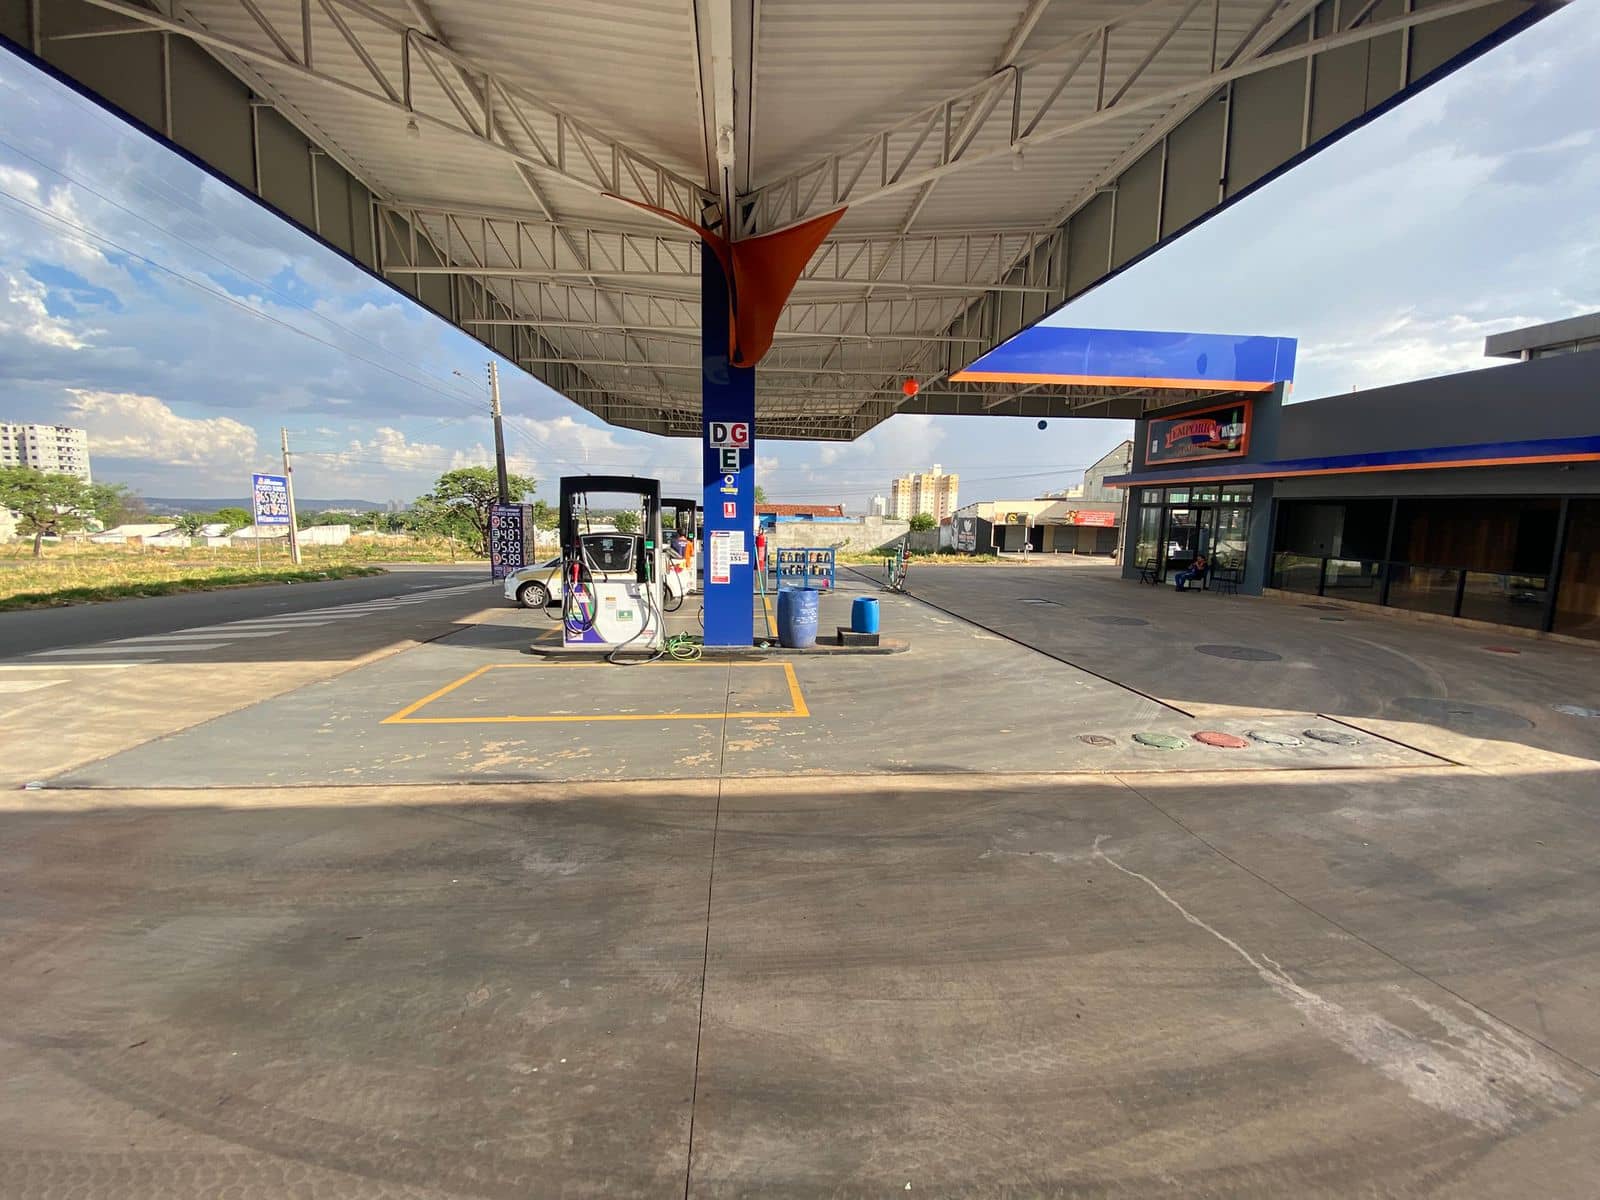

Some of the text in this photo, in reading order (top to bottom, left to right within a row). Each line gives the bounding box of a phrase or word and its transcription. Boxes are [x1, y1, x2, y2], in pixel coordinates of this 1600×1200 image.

[713, 424, 747, 443] D G
[723, 449, 737, 467] E
